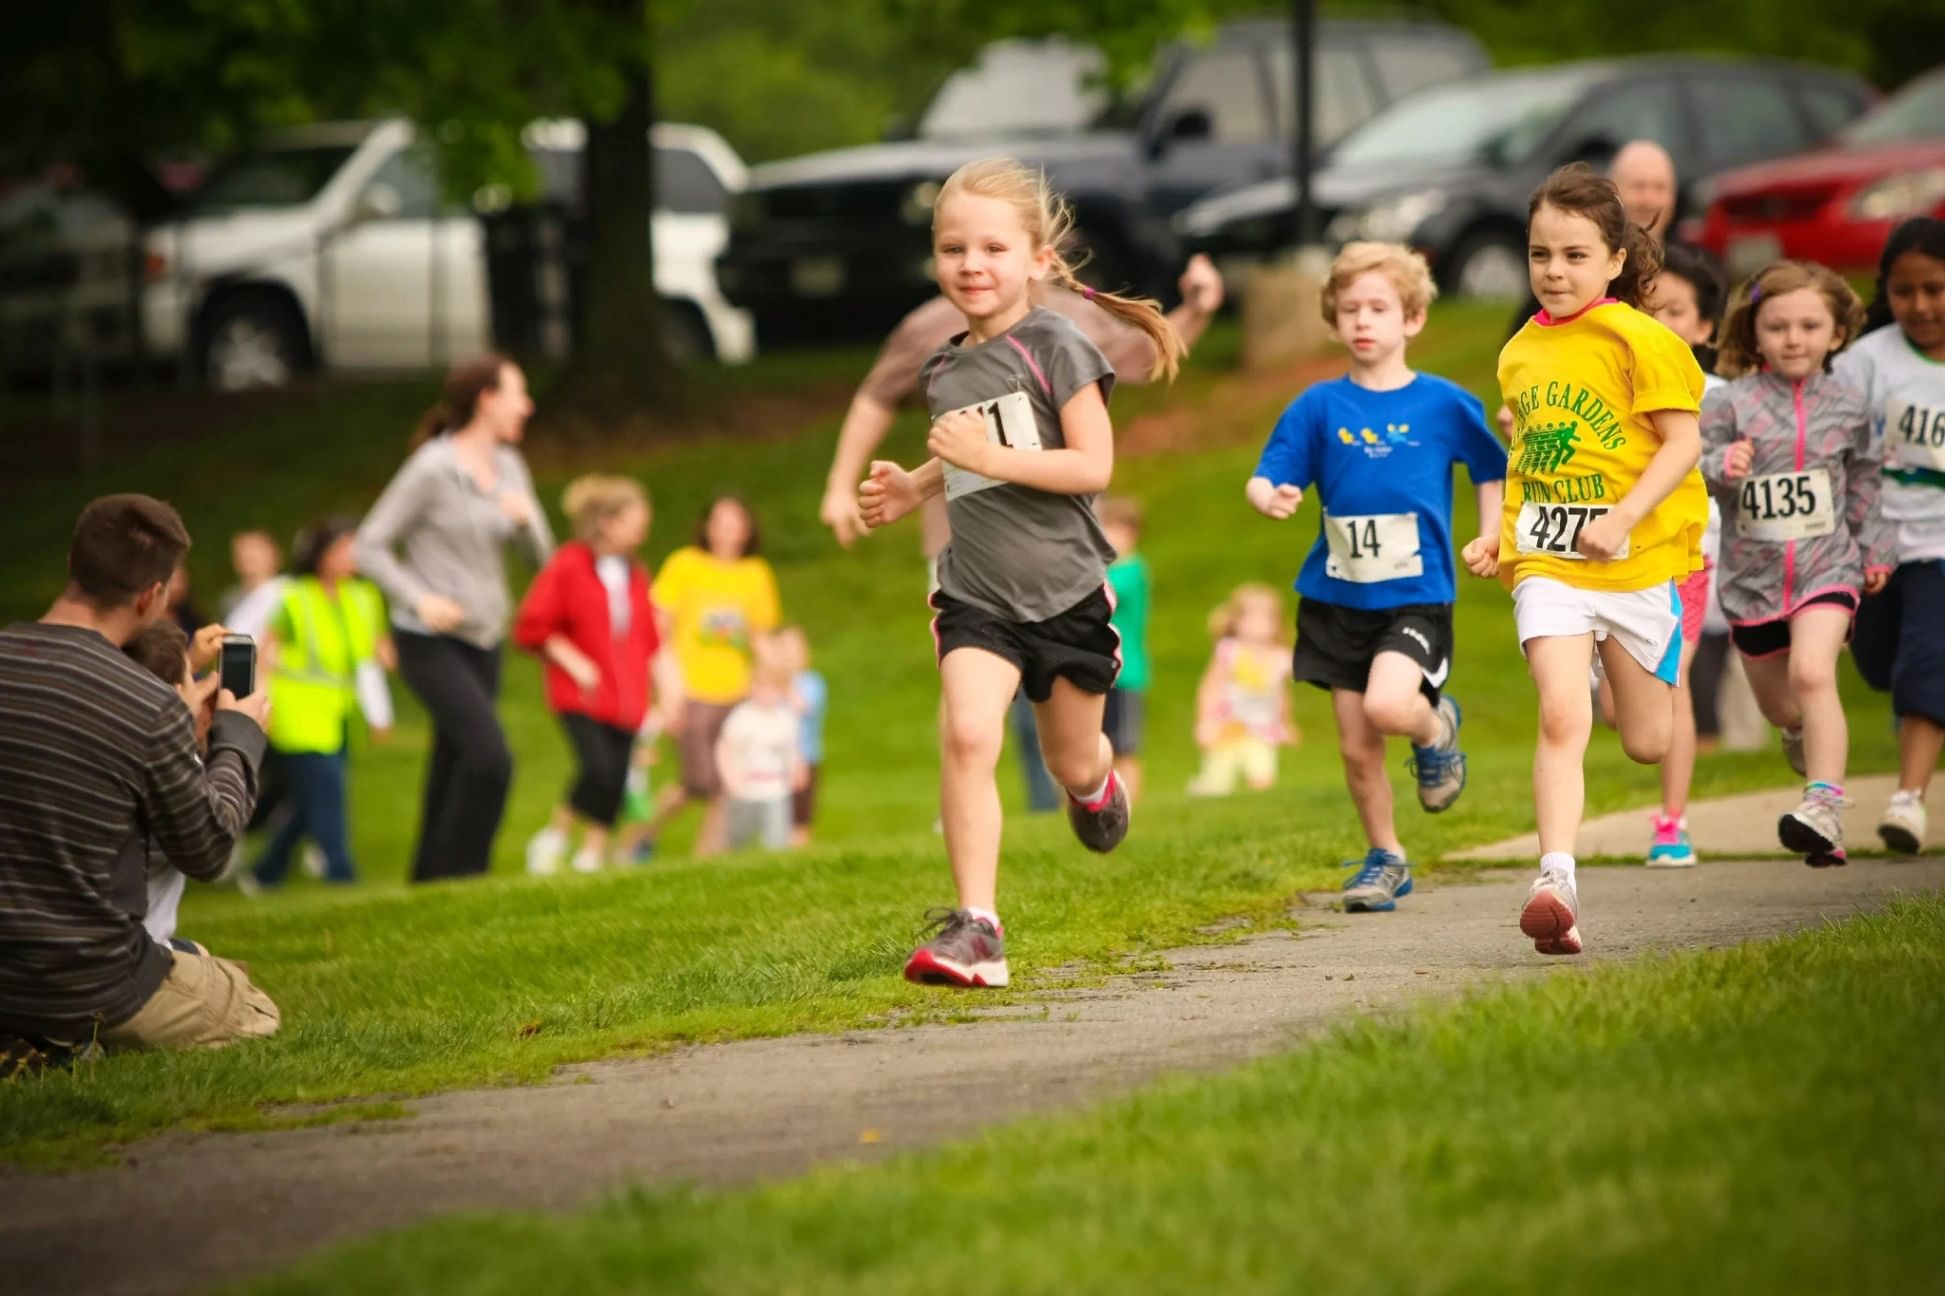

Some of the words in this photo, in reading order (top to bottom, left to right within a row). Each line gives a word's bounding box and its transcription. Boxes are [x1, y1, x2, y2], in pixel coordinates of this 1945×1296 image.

[1547, 381, 1626, 450] GARDENS
[1523, 480, 1551, 504] RUN
[1553, 474, 1605, 504] CLUB
[1741, 476, 1816, 520] 4135
[1346, 519, 1381, 559] 14
